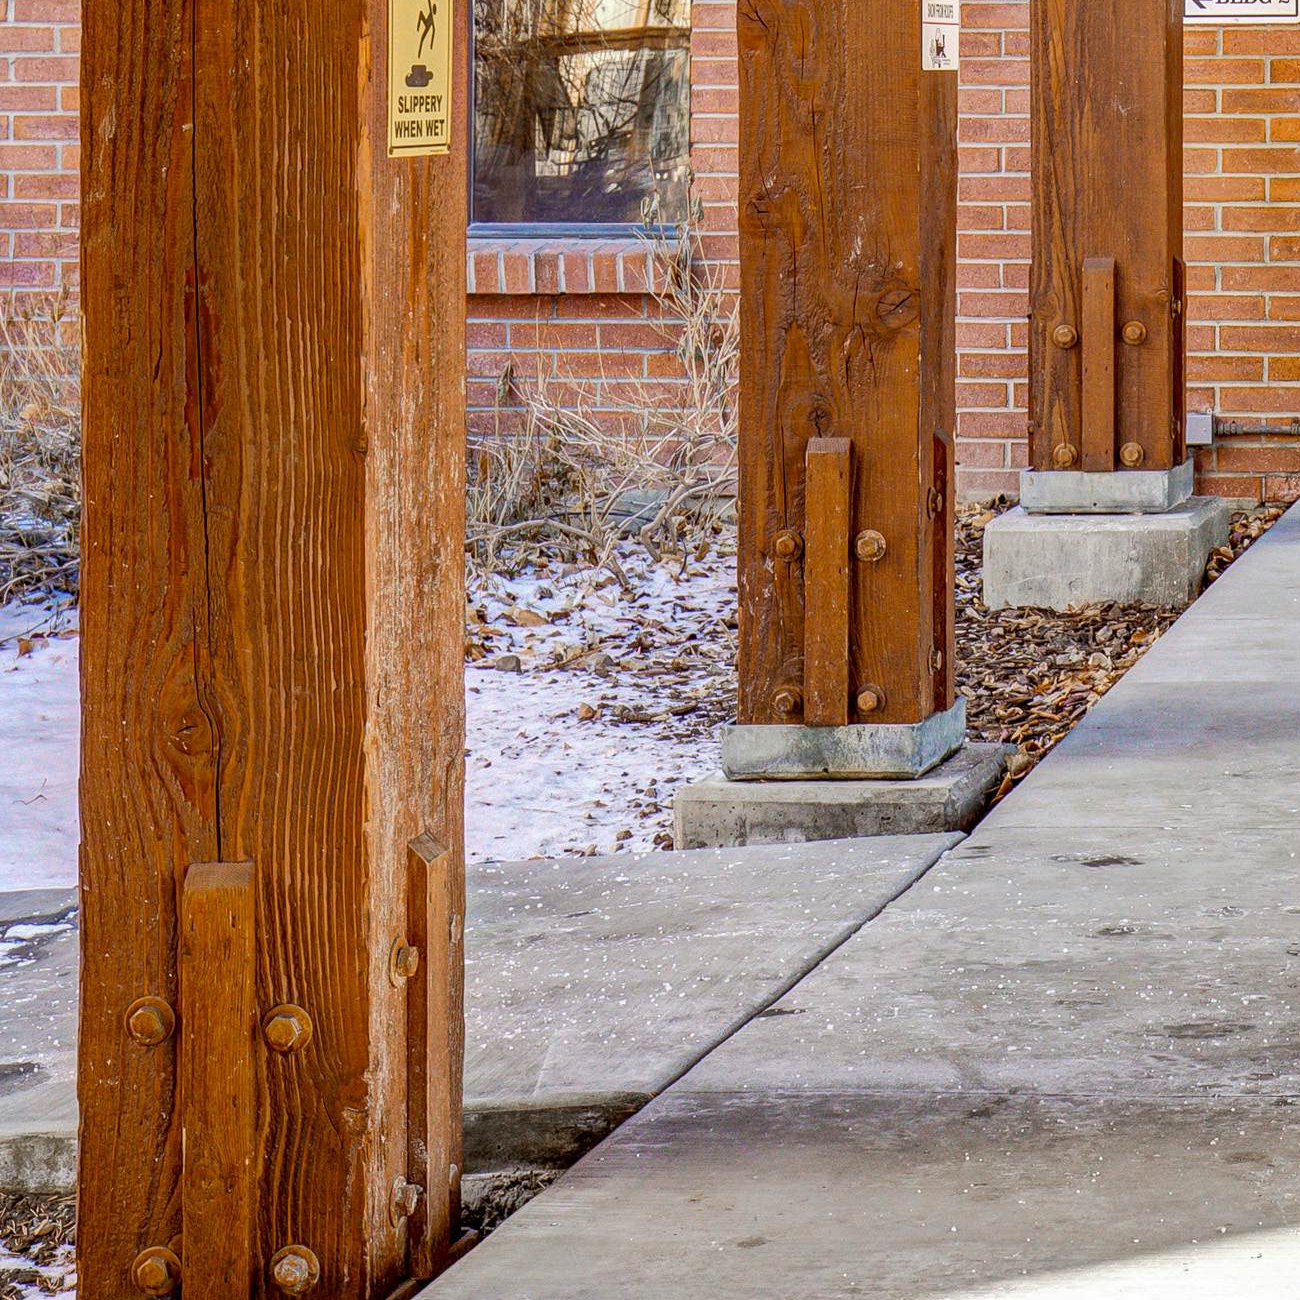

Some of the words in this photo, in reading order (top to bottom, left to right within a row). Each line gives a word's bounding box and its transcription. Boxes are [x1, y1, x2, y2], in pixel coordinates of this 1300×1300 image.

[398, 94, 443, 114] SLIPPERY
[394, 120, 423, 139] WHEN
[425, 119, 445, 137] WET
